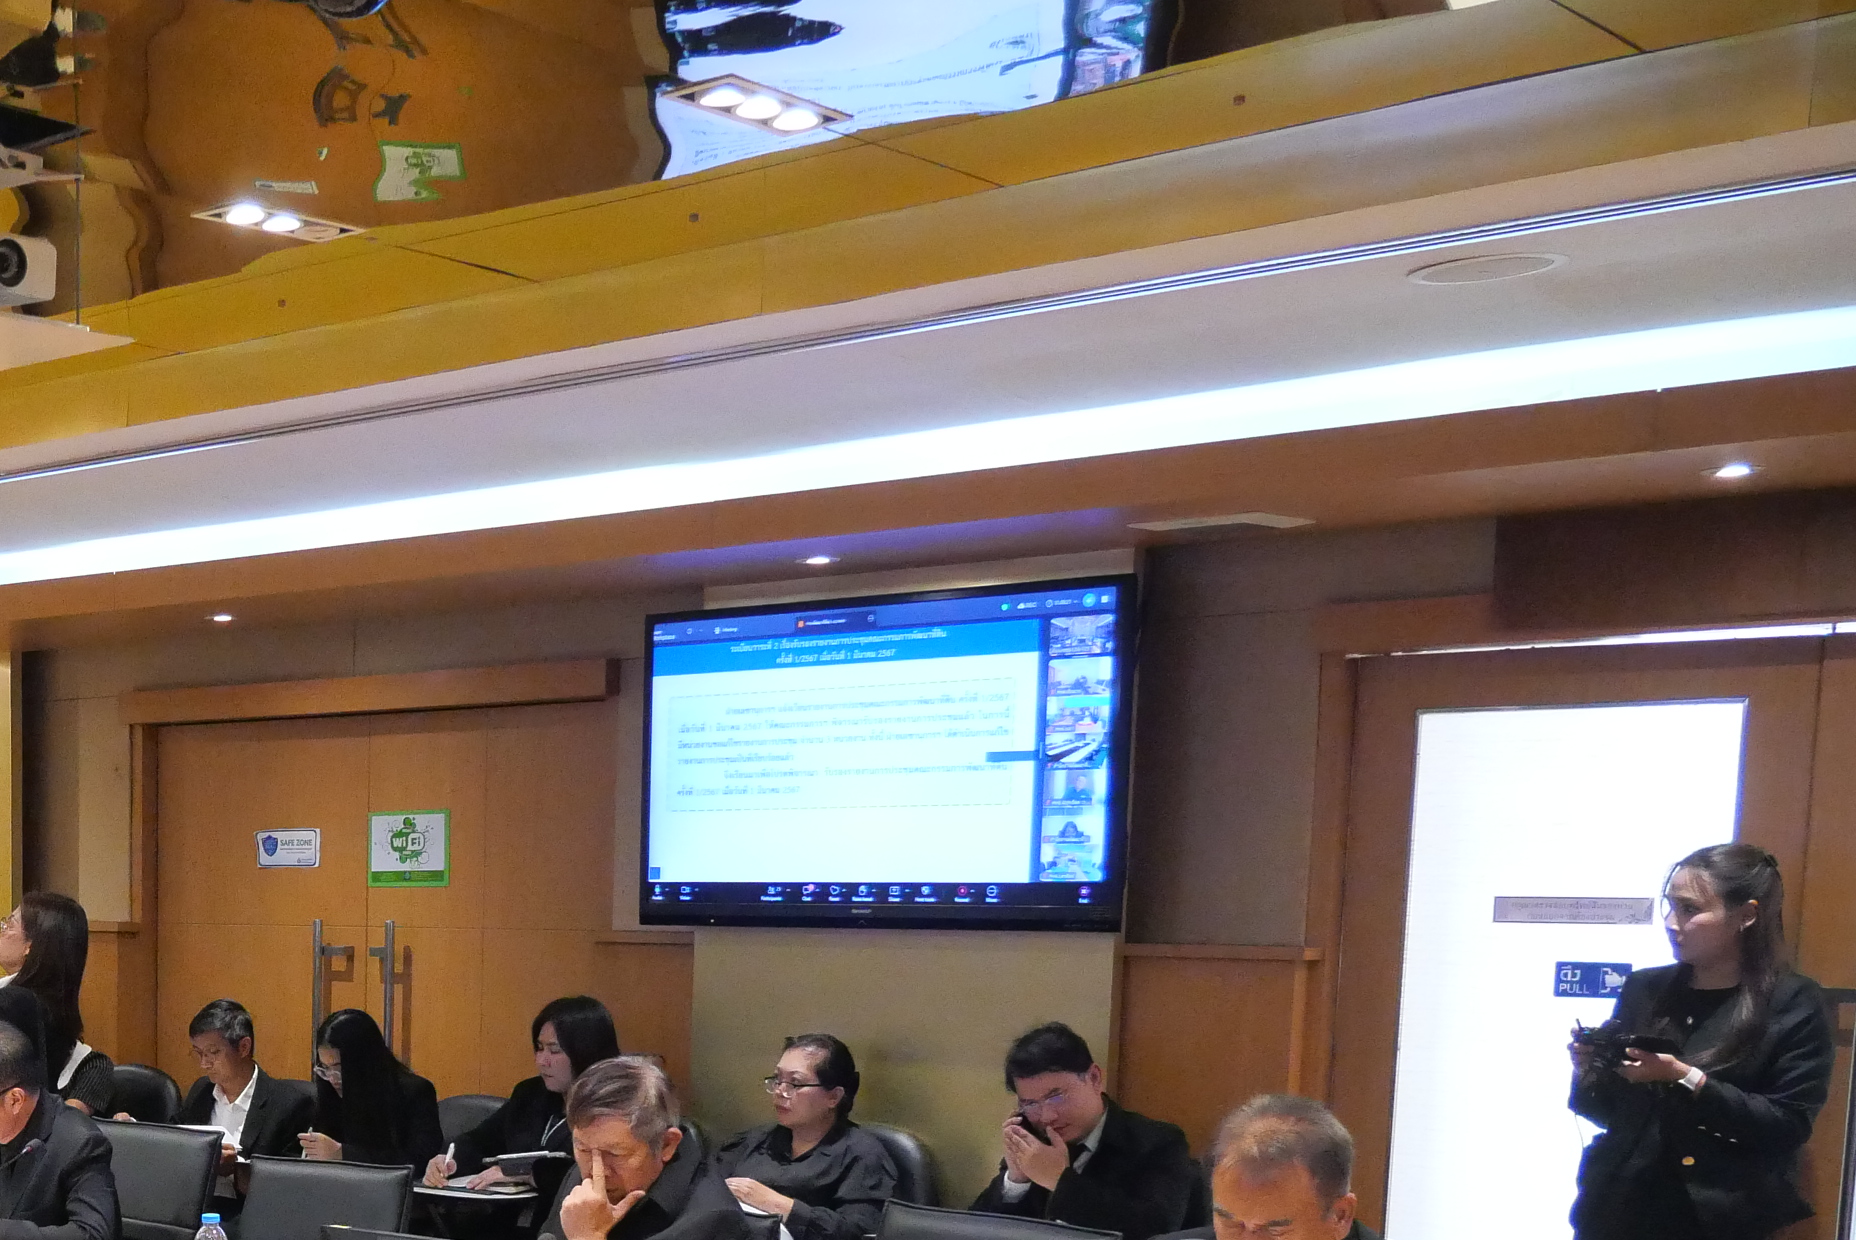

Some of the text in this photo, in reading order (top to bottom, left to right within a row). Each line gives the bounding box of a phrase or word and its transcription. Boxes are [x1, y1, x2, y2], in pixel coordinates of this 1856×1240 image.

[280, 838, 313, 847] SAFE ZONE
[1559, 965, 1581, 982] ดึง
[1559, 983, 1590, 994] PULL
